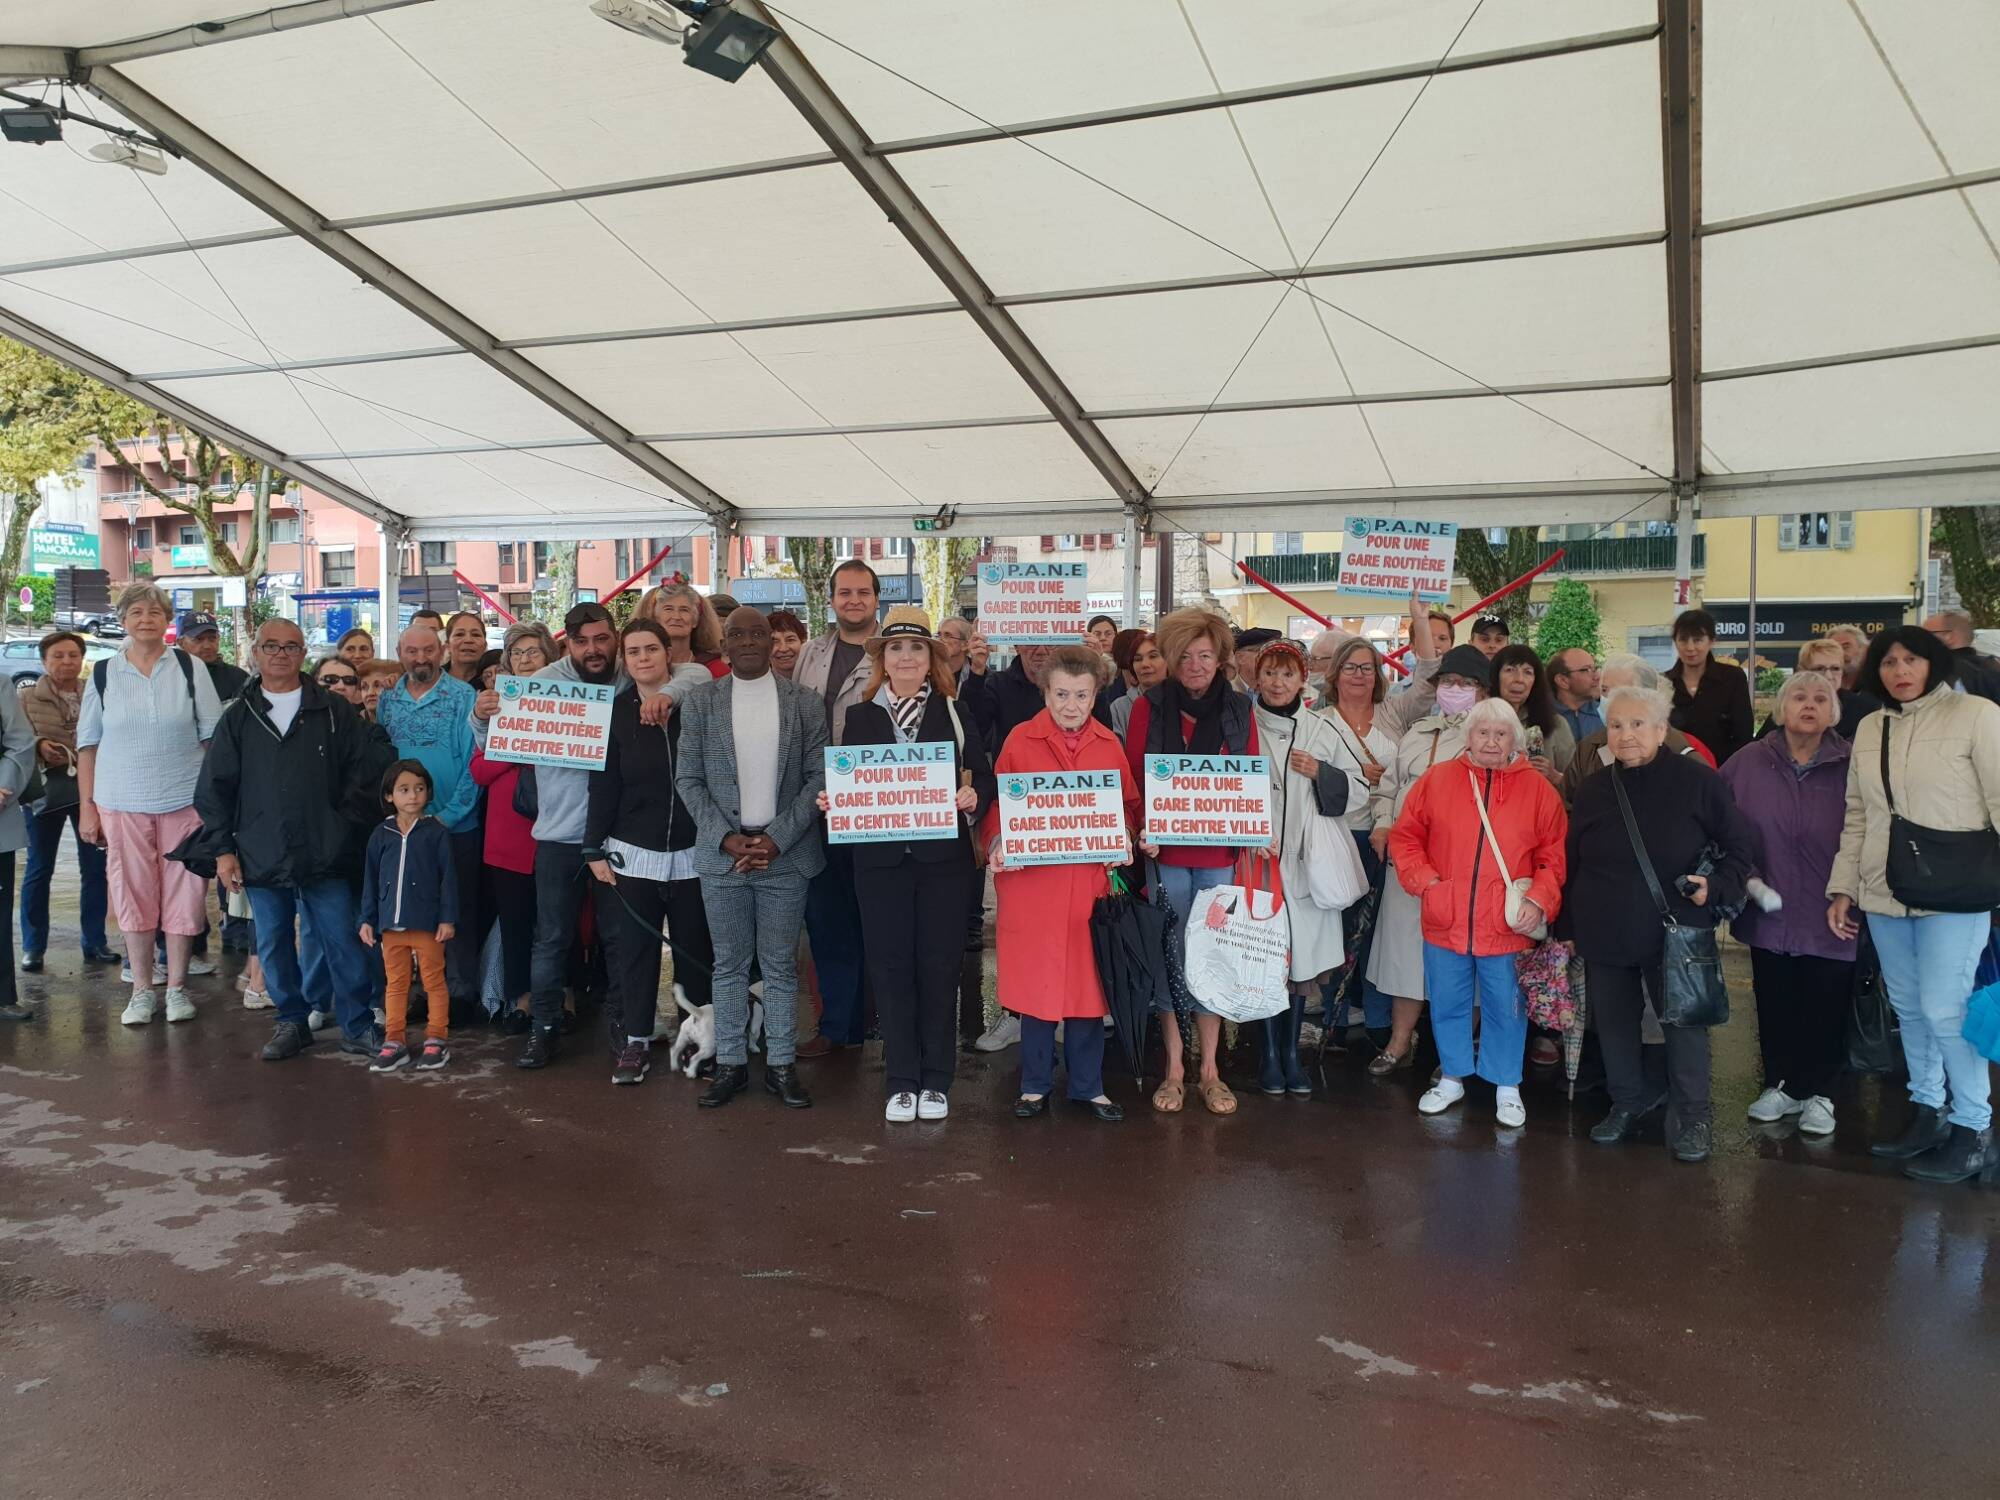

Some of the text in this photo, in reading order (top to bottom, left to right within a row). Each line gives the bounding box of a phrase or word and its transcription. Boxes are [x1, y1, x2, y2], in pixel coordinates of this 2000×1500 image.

[1375, 520, 1450, 535] P.A.N.E
[33, 531, 76, 546] HOTEL
[1367, 535, 1430, 551] POUR UNE
[34, 543, 96, 558] PANORAMA
[1008, 564, 1082, 576] P.A.N.E
[1347, 553, 1446, 572] GARE ROUTIÈRE
[1001, 581, 1064, 594] POUR UNE
[1341, 572, 1448, 592] EN CENTRE VILLE
[743, 591, 768, 600] SNACK
[984, 597, 1082, 614] GARE ROUTIÈRE
[980, 621, 1086, 634] EN CENTRE VILLE
[1715, 622, 1746, 635] EURO
[528, 682, 608, 701] P.A.N.E
[519, 698, 587, 717] POUR UNE
[497, 716, 602, 739] GARE ROUTIÈRE
[489, 736, 604, 759] EN CENTRE VILLE
[861, 747, 947, 763] P.A.N.E
[1179, 759, 1263, 773] P.A.N.E
[854, 766, 927, 784] POUR UNE
[1033, 774, 1115, 789] P.A.N.E
[1172, 776, 1243, 791] POUR UNE
[835, 786, 948, 808] GARE ROUTIÈRE
[1027, 792, 1096, 809] POUR UNE
[1153, 795, 1264, 813] GARE ROUTIÈRE
[831, 811, 953, 831] EN CENTRE VILLE
[1009, 811, 1118, 832] GARE ROUTIÈRE
[1148, 818, 1270, 835] EN CENTRE VILLE
[1006, 835, 1125, 854] EN CENTRE VILLE
